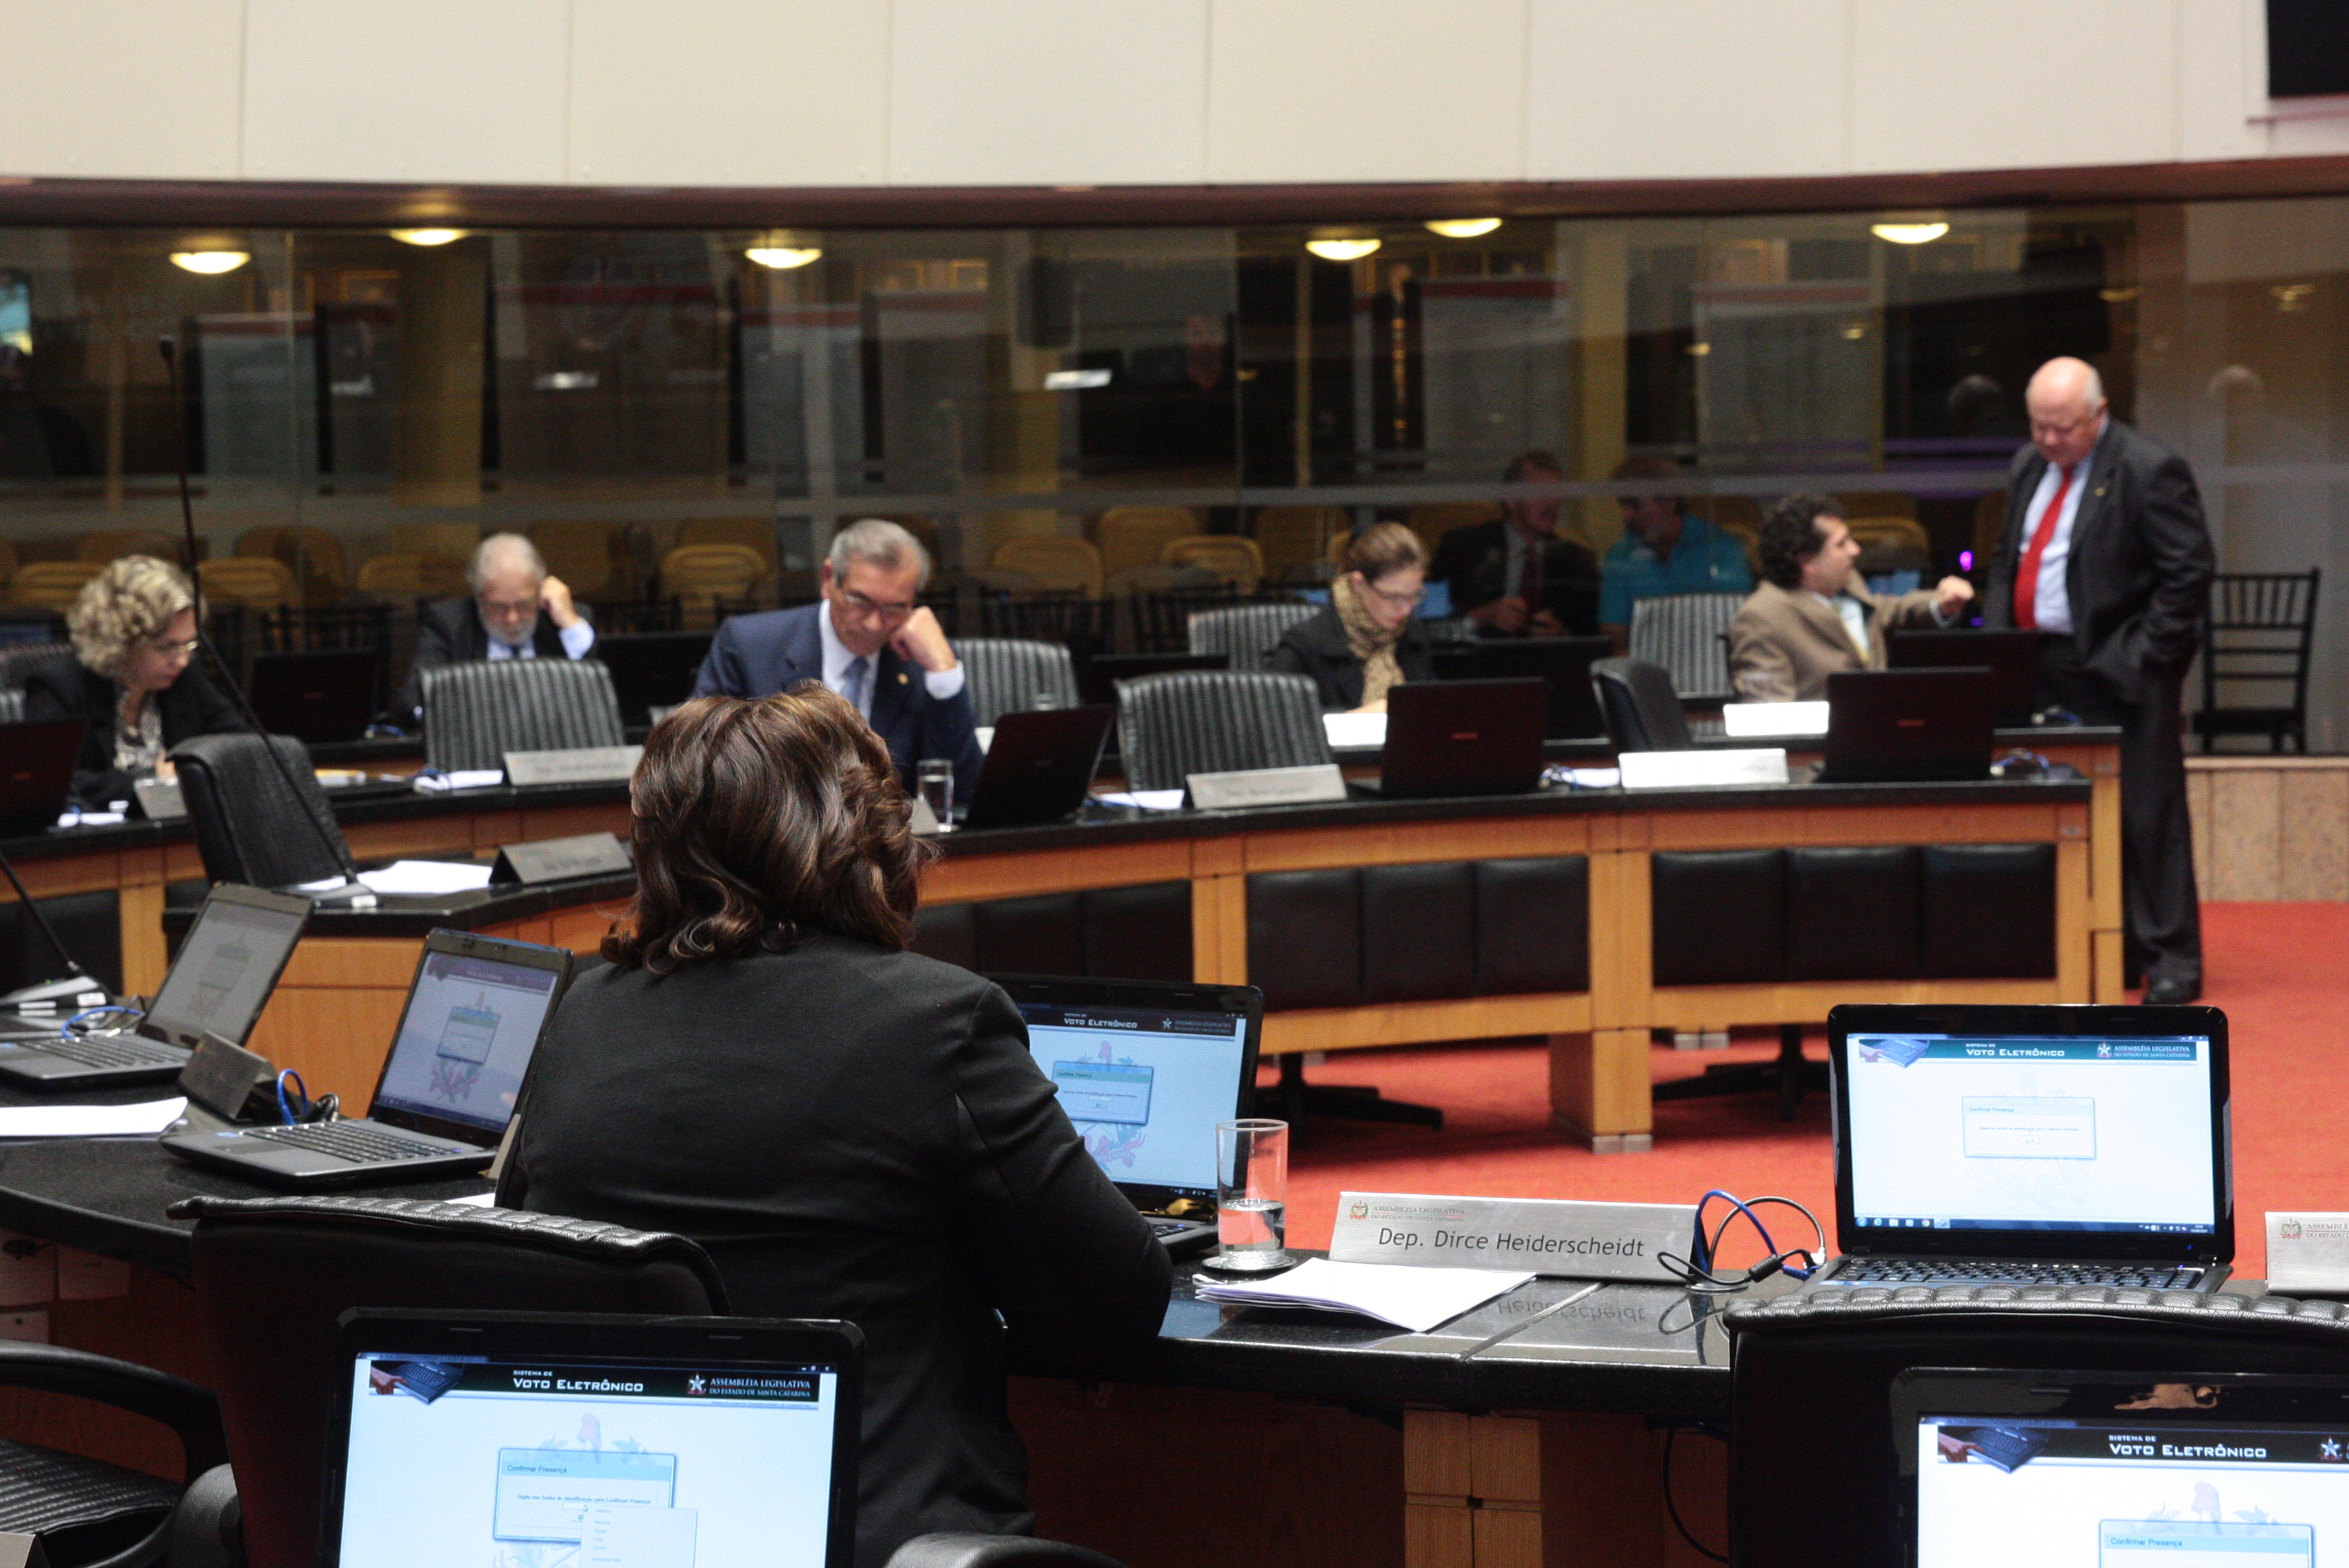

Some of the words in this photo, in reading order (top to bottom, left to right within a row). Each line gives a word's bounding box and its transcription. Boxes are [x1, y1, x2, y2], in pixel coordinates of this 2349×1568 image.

[1419, 1207, 1466, 1215] LEGISLATIVA
[1379, 1228, 1424, 1249] Dep.
[1435, 1230, 1489, 1249] Dirce
[1496, 1233, 1644, 1257] Heiderscheidt
[710, 1378, 759, 1387] ASSEMBLÉIA
[760, 1380, 811, 1389] LEGISLATIVA
[538, 1465, 567, 1474] Presença
[2110, 1537, 2146, 1545] Confirmar
[2148, 1539, 2182, 1548] Presença
